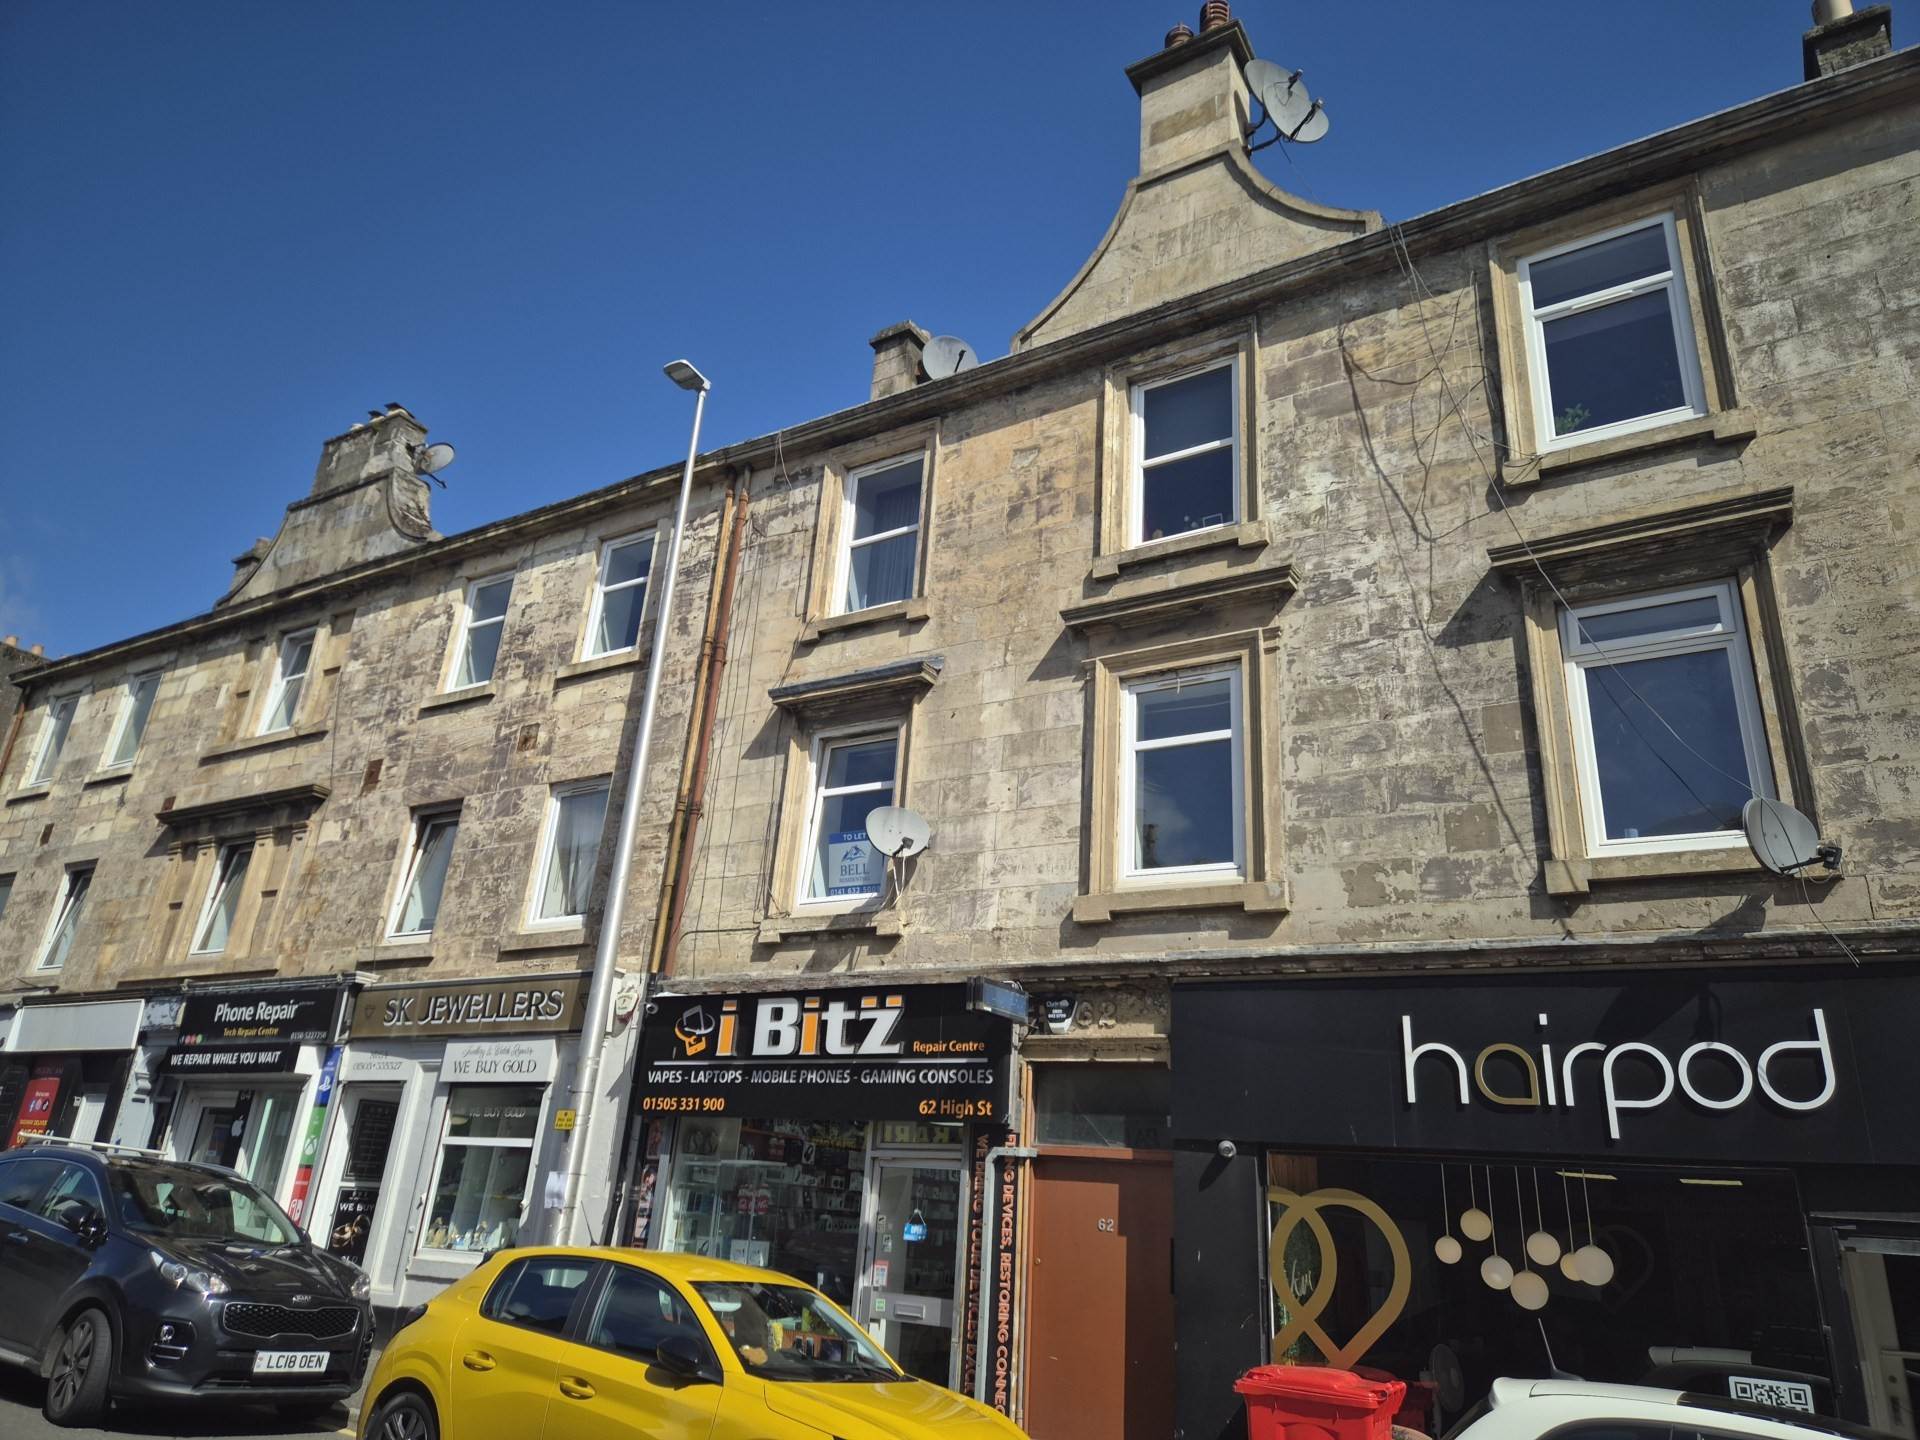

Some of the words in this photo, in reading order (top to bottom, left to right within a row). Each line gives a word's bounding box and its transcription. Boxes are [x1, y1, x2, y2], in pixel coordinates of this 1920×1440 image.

[840, 863, 870, 877] BELL
[214, 1002, 255, 1022] Phone
[256, 999, 299, 1025] Repair
[383, 997, 414, 1026] SK
[417, 989, 565, 1026] JEWELLERS
[223, 1027, 237, 1037] Tech
[237, 1027, 258, 1038] Repair
[258, 1026, 279, 1036] Centre
[913, 1041, 947, 1054] Repair
[949, 1040, 985, 1052] Centre
[170, 1054, 183, 1066] WE
[183, 1053, 211, 1065] REPAIR
[212, 1053, 238, 1065] WHILE
[239, 1052, 257, 1064] YOU
[258, 1051, 282, 1063] WAIT
[452, 1060, 471, 1074] WE
[475, 1060, 499, 1074] BUY
[502, 1059, 537, 1074] GOLD
[1401, 1008, 1837, 1139] hairpod
[648, 1070, 682, 1083] VAPES
[690, 1070, 743, 1083] LAPTOPS
[750, 1070, 797, 1084] MOBILE
[798, 1070, 850, 1084] PHONES
[861, 1069, 916, 1084] GAMING
[919, 1069, 993, 1084] CONSOLES
[642, 1097, 678, 1111] 01505
[679, 1097, 700, 1111] 331
[702, 1097, 725, 1111] 900
[918, 1100, 937, 1114] 62
[940, 1099, 974, 1118] High
[977, 1100, 993, 1116] St
[976, 1134, 989, 1158] WE
[1004, 1134, 1017, 1183] FIING
[339, 1202, 355, 1212] WE
[356, 1202, 376, 1212] BUY
[1000, 1184, 1015, 1250] DEVICES,
[1097, 1219, 1114, 1232] 62
[996, 1252, 1012, 1345] RESTORING
[266, 1354, 297, 1369] LC18
[299, 1354, 325, 1369] OEN
